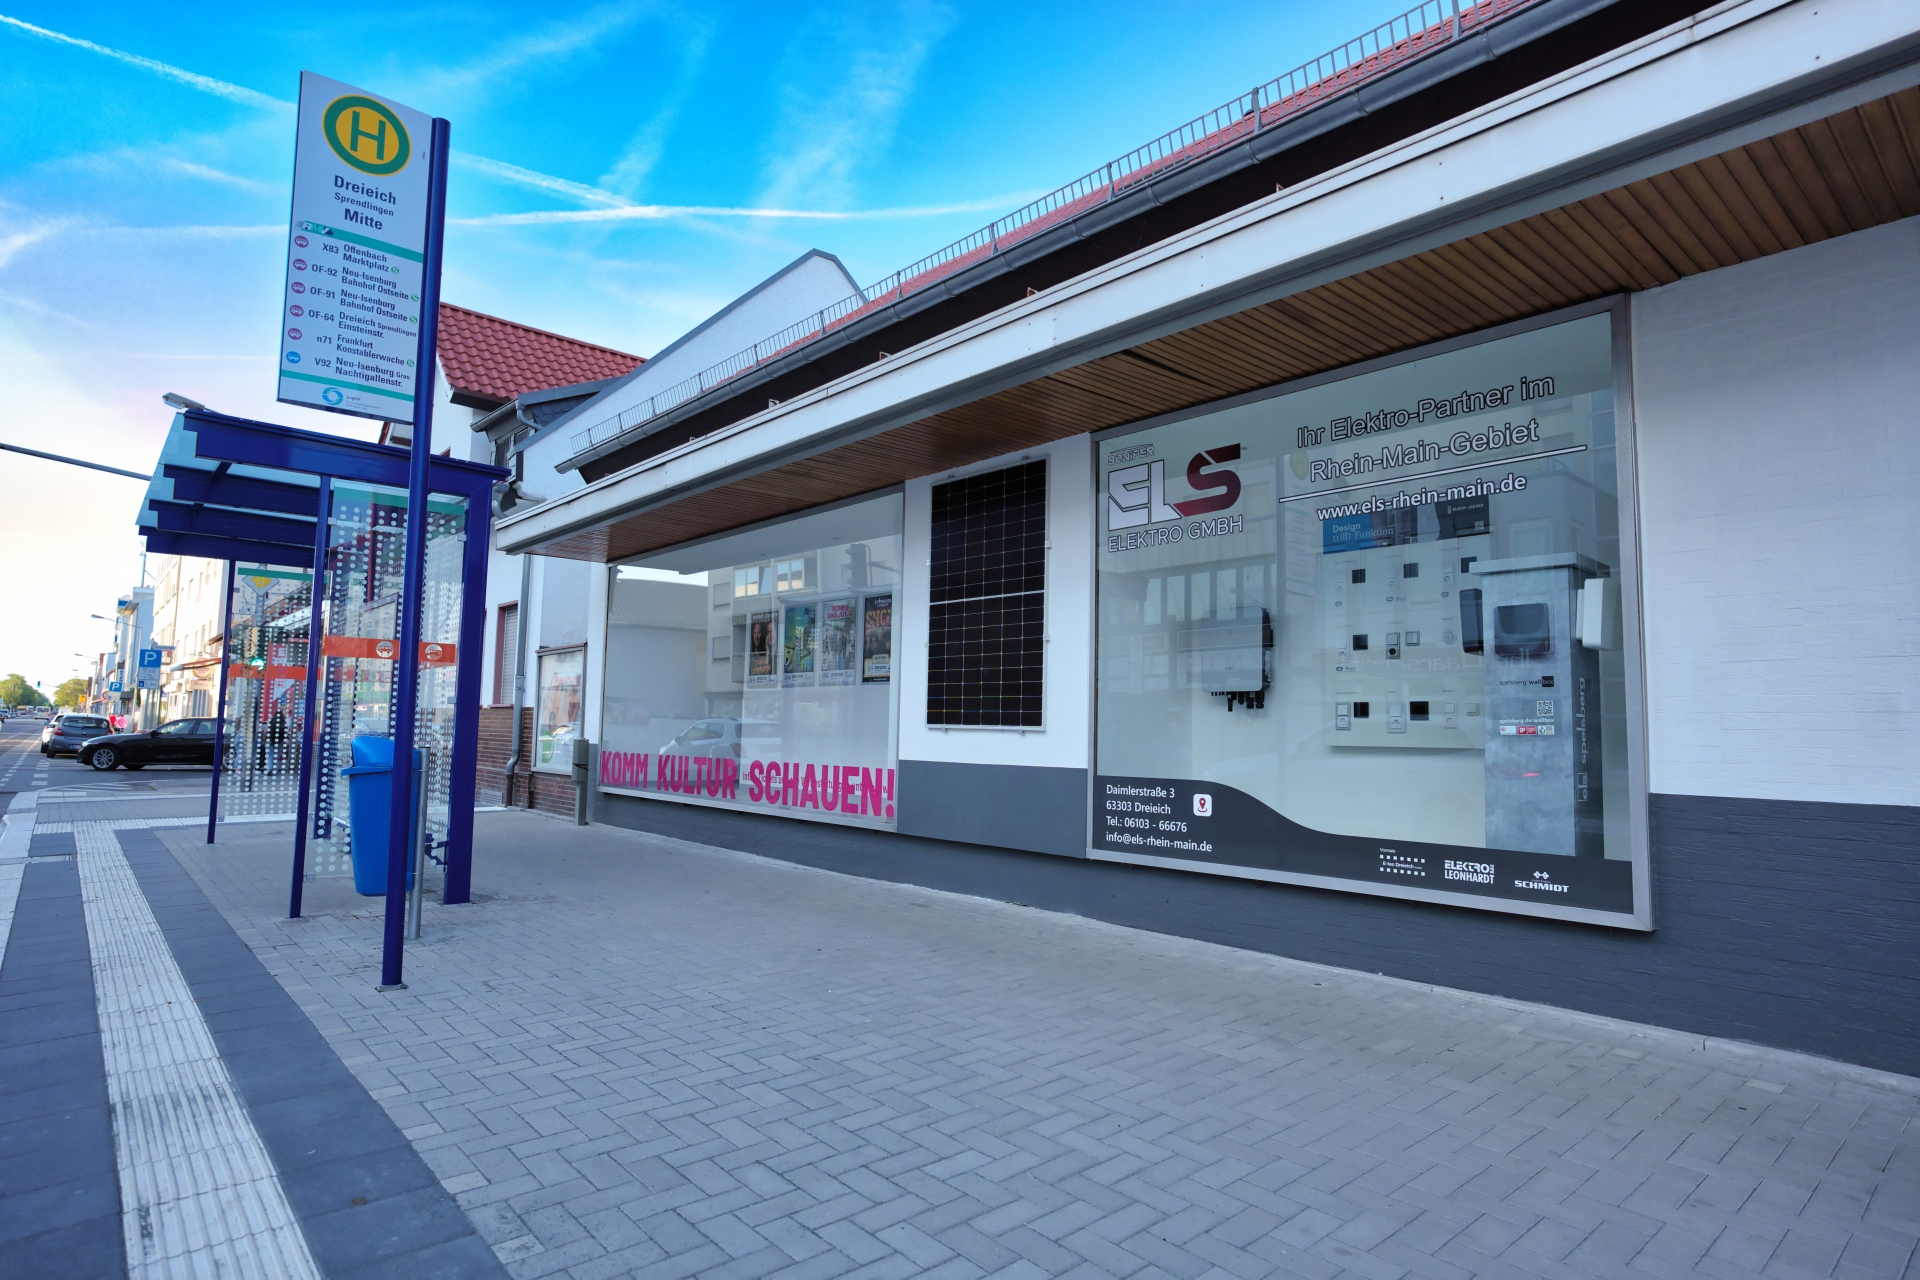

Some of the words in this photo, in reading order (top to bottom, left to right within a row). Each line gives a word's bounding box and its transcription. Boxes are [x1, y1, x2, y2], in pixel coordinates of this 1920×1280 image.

[334, 175, 396, 205] Dreieich
[335, 192, 394, 217] Sprendlingen
[302, 221, 330, 235] RMV
[344, 208, 383, 230] Mitte
[322, 243, 339, 254] X83
[344, 244, 387, 262] Offenbach
[343, 253, 389, 272] Marktplatz
[312, 264, 338, 277] OF-92
[342, 267, 396, 289] Neu-Isenburg
[310, 286, 336, 299] OF-91
[340, 289, 396, 311] Neu-Isenburg
[341, 276, 376, 291] Bahnhof
[378, 286, 409, 300] Ostseite
[340, 298, 375, 313] Bahnhof
[376, 308, 408, 322] Ostseite
[308, 310, 335, 322] OF-64
[339, 312, 376, 327] Dreieich
[378, 322, 417, 338] Sprendlingen
[338, 321, 385, 339] Einsteinstr.
[317, 336, 332, 345] n71
[337, 334, 373, 349] Frankfurt
[336, 344, 405, 365] Konstablerwache
[315, 357, 331, 367] V92
[336, 357, 394, 378] Neu-Isenburg
[335, 366, 403, 388] Nachtigallenstr.
[1298, 425, 1325, 448] Ihr
[1330, 384, 1514, 442] Elektro-Partner
[1521, 376, 1555, 401] im
[1310, 418, 1540, 482] Rhein-Main-Gebiet
[1108, 442, 1241, 531] ELS
[1317, 472, 1527, 521] www.els-rhein-main.de
[1108, 525, 1183, 553] ELEKTRO
[1188, 514, 1243, 540] GMBH
[1332, 523, 1360, 533] Design
[1333, 532, 1351, 542] trifft
[1355, 528, 1394, 540] Funktion
[1576, 677, 1588, 764] spelsberg
[602, 750, 649, 789] KOMM
[656, 754, 737, 800] KULTUR
[748, 760, 895, 818] SCHAUEN!
[1106, 784, 1167, 798] Daimlerstraße
[1170, 788, 1175, 798] 3
[1106, 800, 1132, 811] 63303
[1134, 802, 1171, 814] Dreieich
[1106, 816, 1122, 826] Tel.:
[1124, 818, 1150, 829] 06103
[1159, 820, 1187, 832] 66676
[1106, 831, 1212, 852] info@els-rhein-main.de
[1444, 860, 1490, 873] ELEKTRO
[1444, 870, 1494, 884] LEONHARDT
[1514, 880, 1569, 892] SCHMIDT
